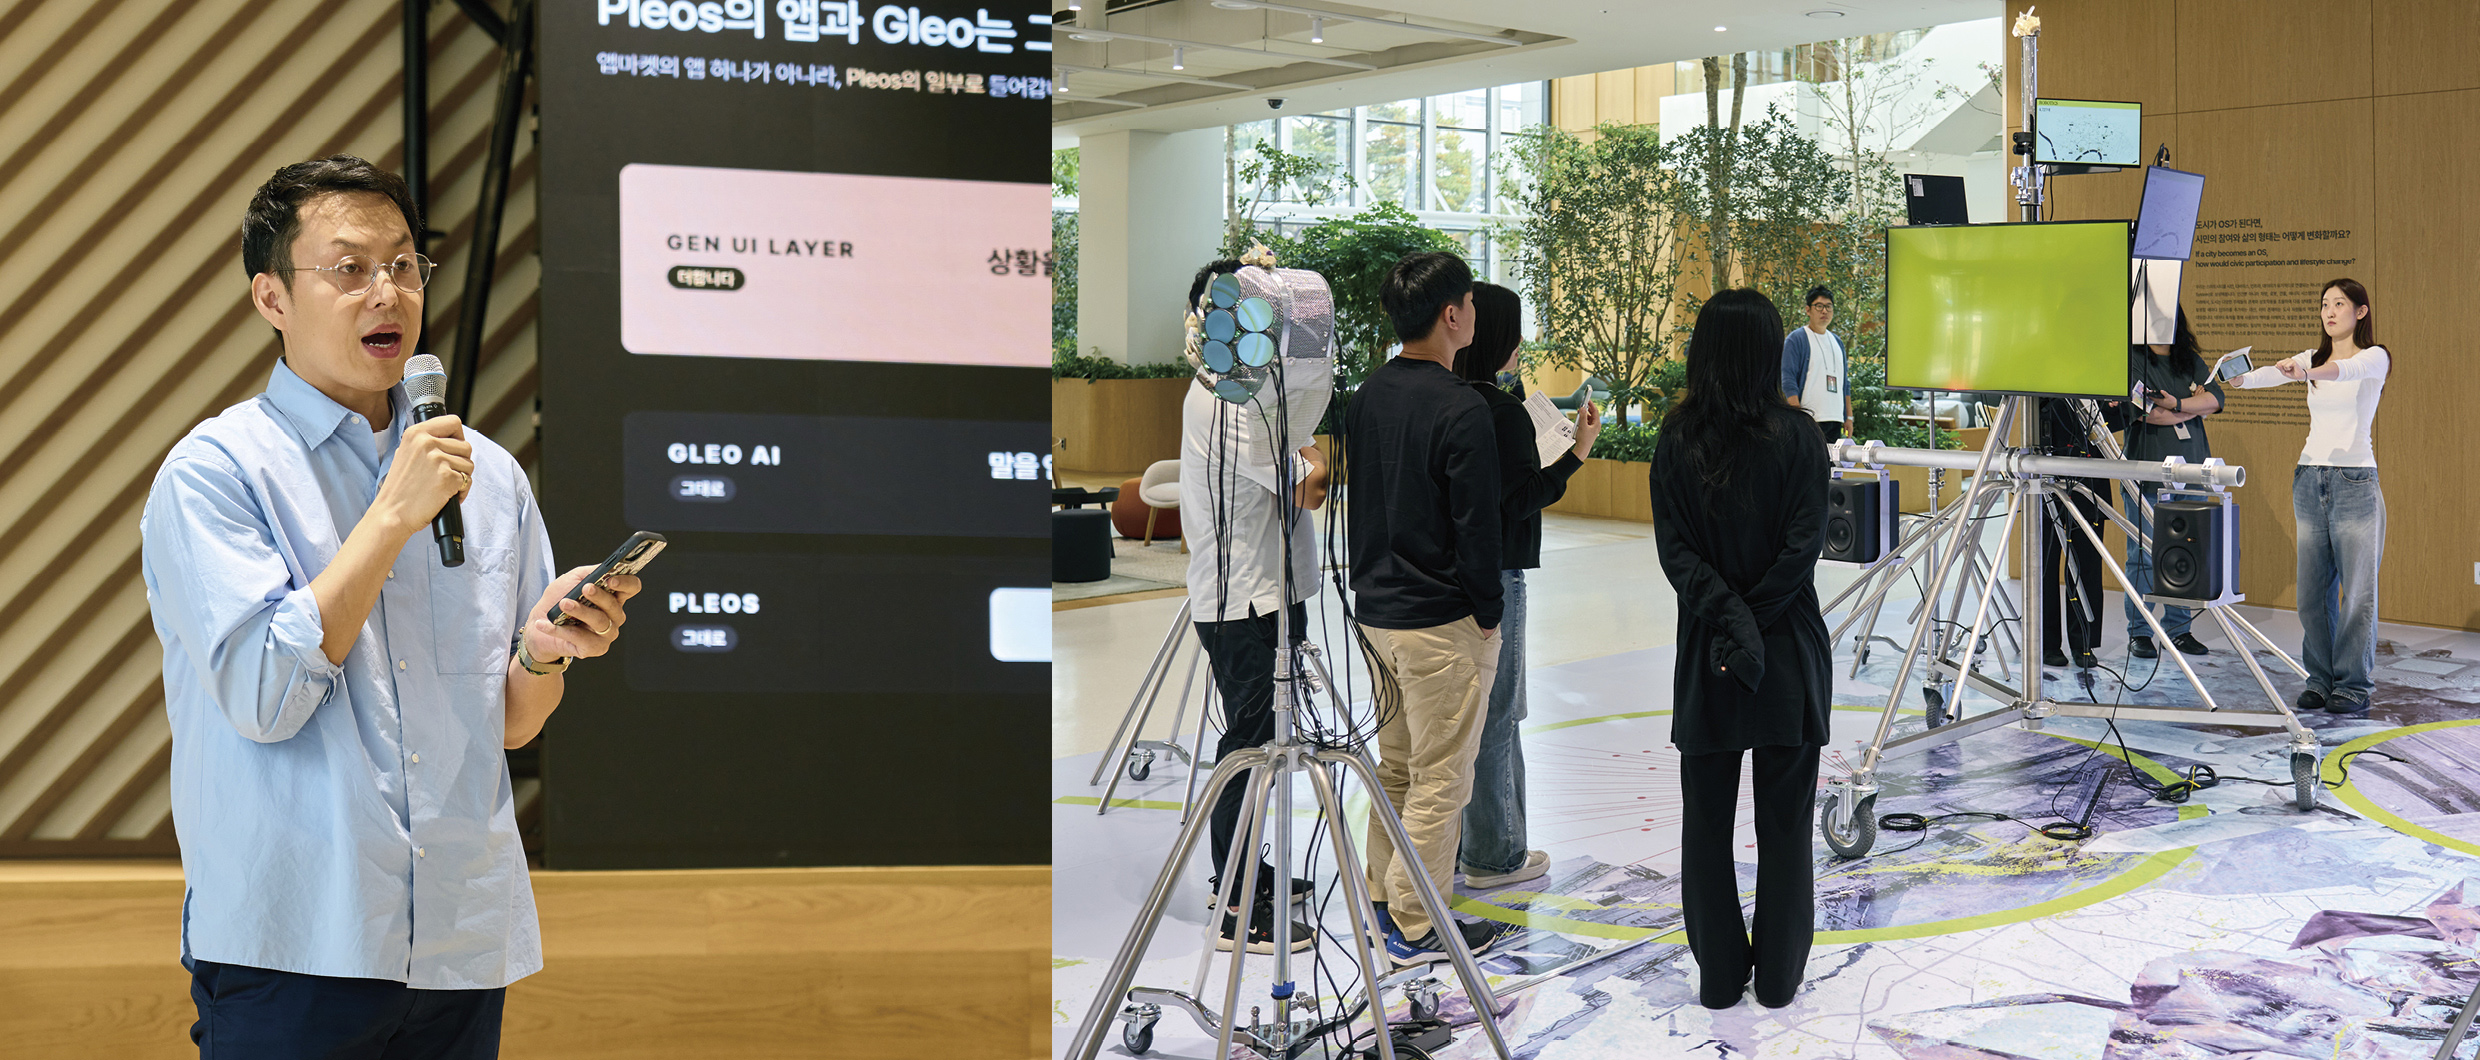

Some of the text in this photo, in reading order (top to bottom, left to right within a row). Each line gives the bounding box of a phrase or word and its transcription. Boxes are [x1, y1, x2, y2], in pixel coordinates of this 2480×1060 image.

[597, 0, 766, 40] Pleos의
[776, 0, 865, 45] 앱과
[872, 4, 1018, 54] Gleo는
[596, 51, 1052, 99] 앱마켓의 앱 하나가 아니라, Pleos의 일부로 들어갑
[2195, 218, 2263, 229] 도시가 OS가 된다면,
[667, 235, 854, 257] GEN UI LAYER
[2195, 234, 2217, 243] 시민의
[2282, 231, 2305, 241] 어떻게
[2307, 229, 2351, 240] 변화할까요?
[2205, 250, 2217, 258] city
[2256, 249, 2269, 257] OS,
[2245, 259, 2286, 268] participation
[2299, 258, 2326, 266] lifestyle
[2326, 258, 2356, 266] change?
[667, 443, 781, 466] GLEO AI
[669, 592, 760, 614] PLEOS
